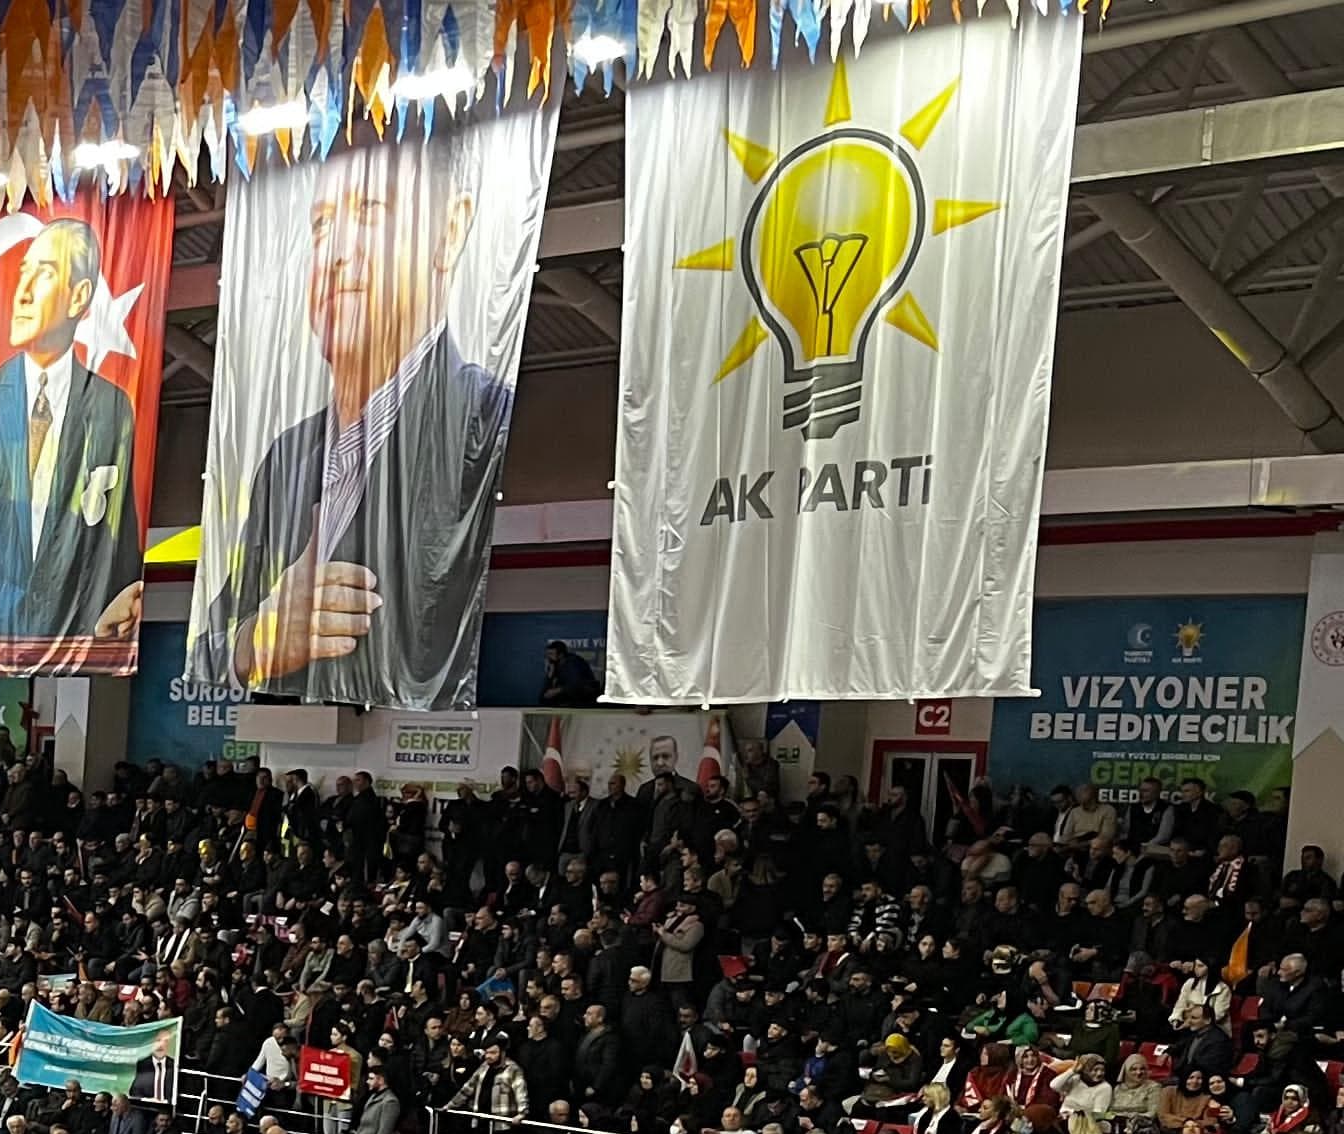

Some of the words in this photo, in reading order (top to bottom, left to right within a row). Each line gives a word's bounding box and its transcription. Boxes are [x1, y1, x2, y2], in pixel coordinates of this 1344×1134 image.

[700, 470, 775, 526] AK
[919, 705, 950, 727] C2
[397, 732, 472, 751] GERÇEK
